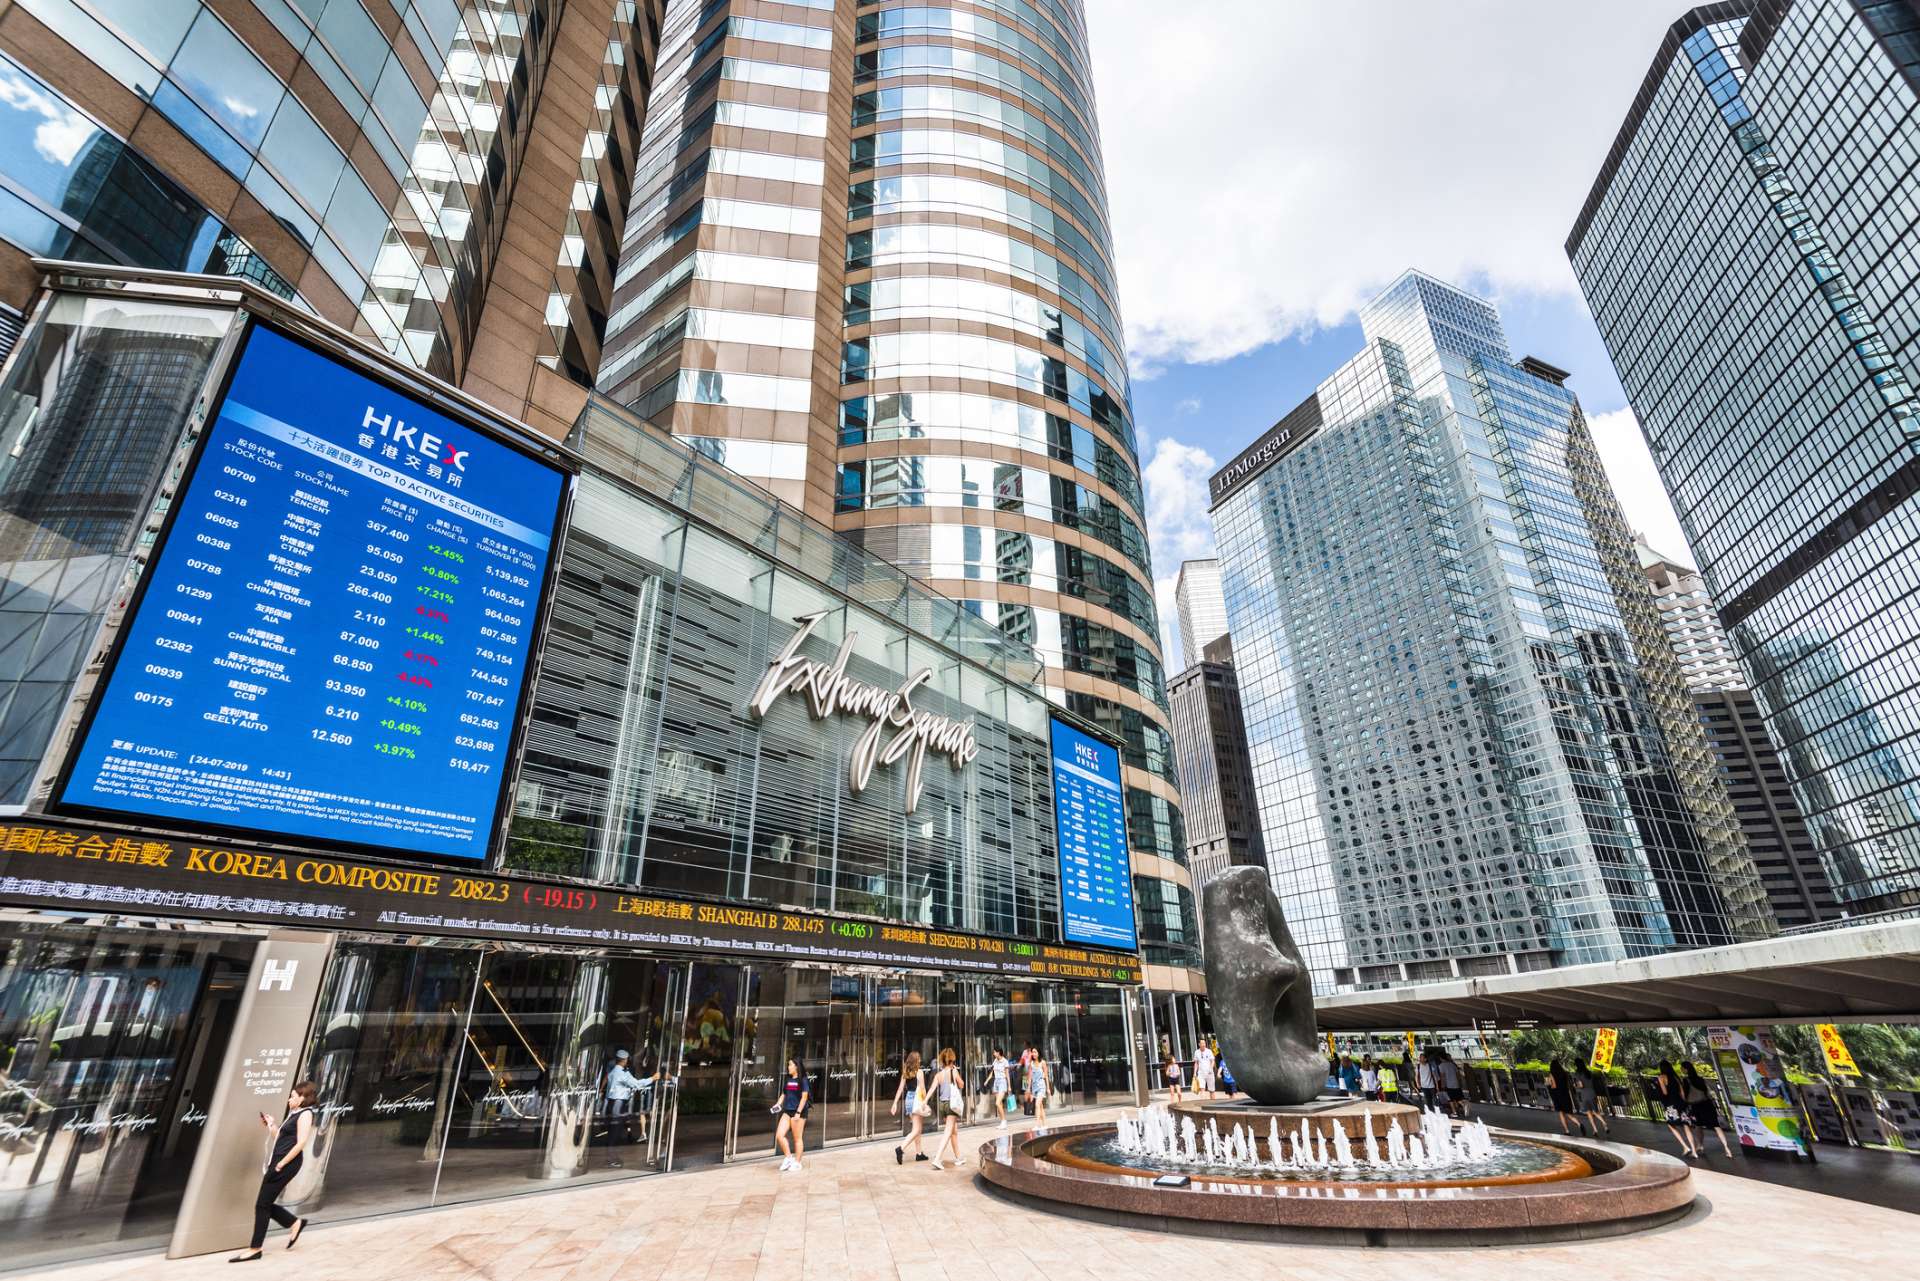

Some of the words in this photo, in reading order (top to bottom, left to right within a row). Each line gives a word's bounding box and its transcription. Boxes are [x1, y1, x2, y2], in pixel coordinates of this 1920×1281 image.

[362, 406, 469, 472] HKEX
[224, 443, 255, 460] STOCK
[257, 456, 284, 470] CODE
[358, 433, 463, 488] 香港交易所
[223, 466, 256, 483] 00700
[295, 470, 323, 486] STOCK
[325, 482, 350, 497] NAME
[214, 490, 247, 507] 02318
[290, 495, 330, 515] TENCENT
[368, 464, 391, 479] TOP
[394, 475, 406, 486] 10
[408, 482, 447, 503] ACTIVE
[448, 497, 504, 528] SECURITIES
[205, 512, 239, 529] 06055
[381, 505, 404, 518] PRICE
[283, 520, 305, 532] PING
[306, 527, 320, 536] AN
[367, 520, 410, 542] 367.400
[426, 523, 456, 540] CHANGE
[197, 534, 231, 551] 00388
[475, 542, 511, 561] TURNOVER
[366, 544, 403, 564] 95.050
[427, 544, 464, 564] +2.45%
[186, 559, 222, 575] 00788
[274, 564, 300, 577] HKEX
[360, 565, 398, 584] 23.050
[421, 565, 460, 585] +0.80%
[485, 565, 529, 588] 5,139,952
[176, 584, 212, 600] 01299
[246, 582, 276, 597] CHINA
[278, 592, 312, 607] TOWER
[347, 583, 392, 604] 266.400
[416, 585, 454, 604] +7.21%
[481, 586, 525, 607] 1,065,264
[166, 609, 202, 625] 00941
[262, 614, 279, 624] AIA
[354, 609, 386, 627] 2.110
[485, 608, 521, 626] 964,050
[228, 631, 259, 646] CHINA
[261, 640, 297, 655] MOBILE
[340, 631, 380, 650] 87.000
[405, 626, 444, 645] +1.44%
[480, 627, 517, 645] 807,585
[156, 637, 193, 654] 02382
[333, 654, 373, 673] 68.850
[476, 647, 513, 666] 749,154
[145, 664, 183, 680] 00939
[213, 657, 250, 672] SUNNY
[250, 667, 292, 682] OPTICAL
[471, 669, 508, 687] 744,543
[234, 690, 257, 701] CCB
[325, 679, 366, 698] 93.950
[134, 691, 173, 707] 00175
[386, 696, 428, 713] +4.10%
[466, 689, 504, 707] 707,647
[203, 712, 238, 726] GEELY
[239, 719, 269, 732] AUTO
[325, 705, 359, 721] 6.210
[460, 713, 499, 730] 682,563
[380, 719, 422, 736] +0.49%
[311, 728, 352, 746] 12.560
[455, 735, 495, 752] 623,698
[136, 745, 178, 760] UPDATE:
[374, 742, 416, 760] +3.97%
[449, 758, 490, 774] 519,477
[184, 847, 289, 880] KOREA
[296, 860, 441, 896] COMPOSITE
[450, 878, 510, 902] 2082.3
[612, 896, 693, 921] 上海B股指數
[698, 905, 766, 929] SHANGHAI
[769, 914, 777, 929] B
[782, 916, 824, 934] 288.1475
[929, 932, 969, 949] SHENZHEN
[971, 937, 976, 950] B
[377, 911, 396, 923] All
[246, 1078, 285, 1087] Exchange
[254, 1086, 282, 1095] Square
